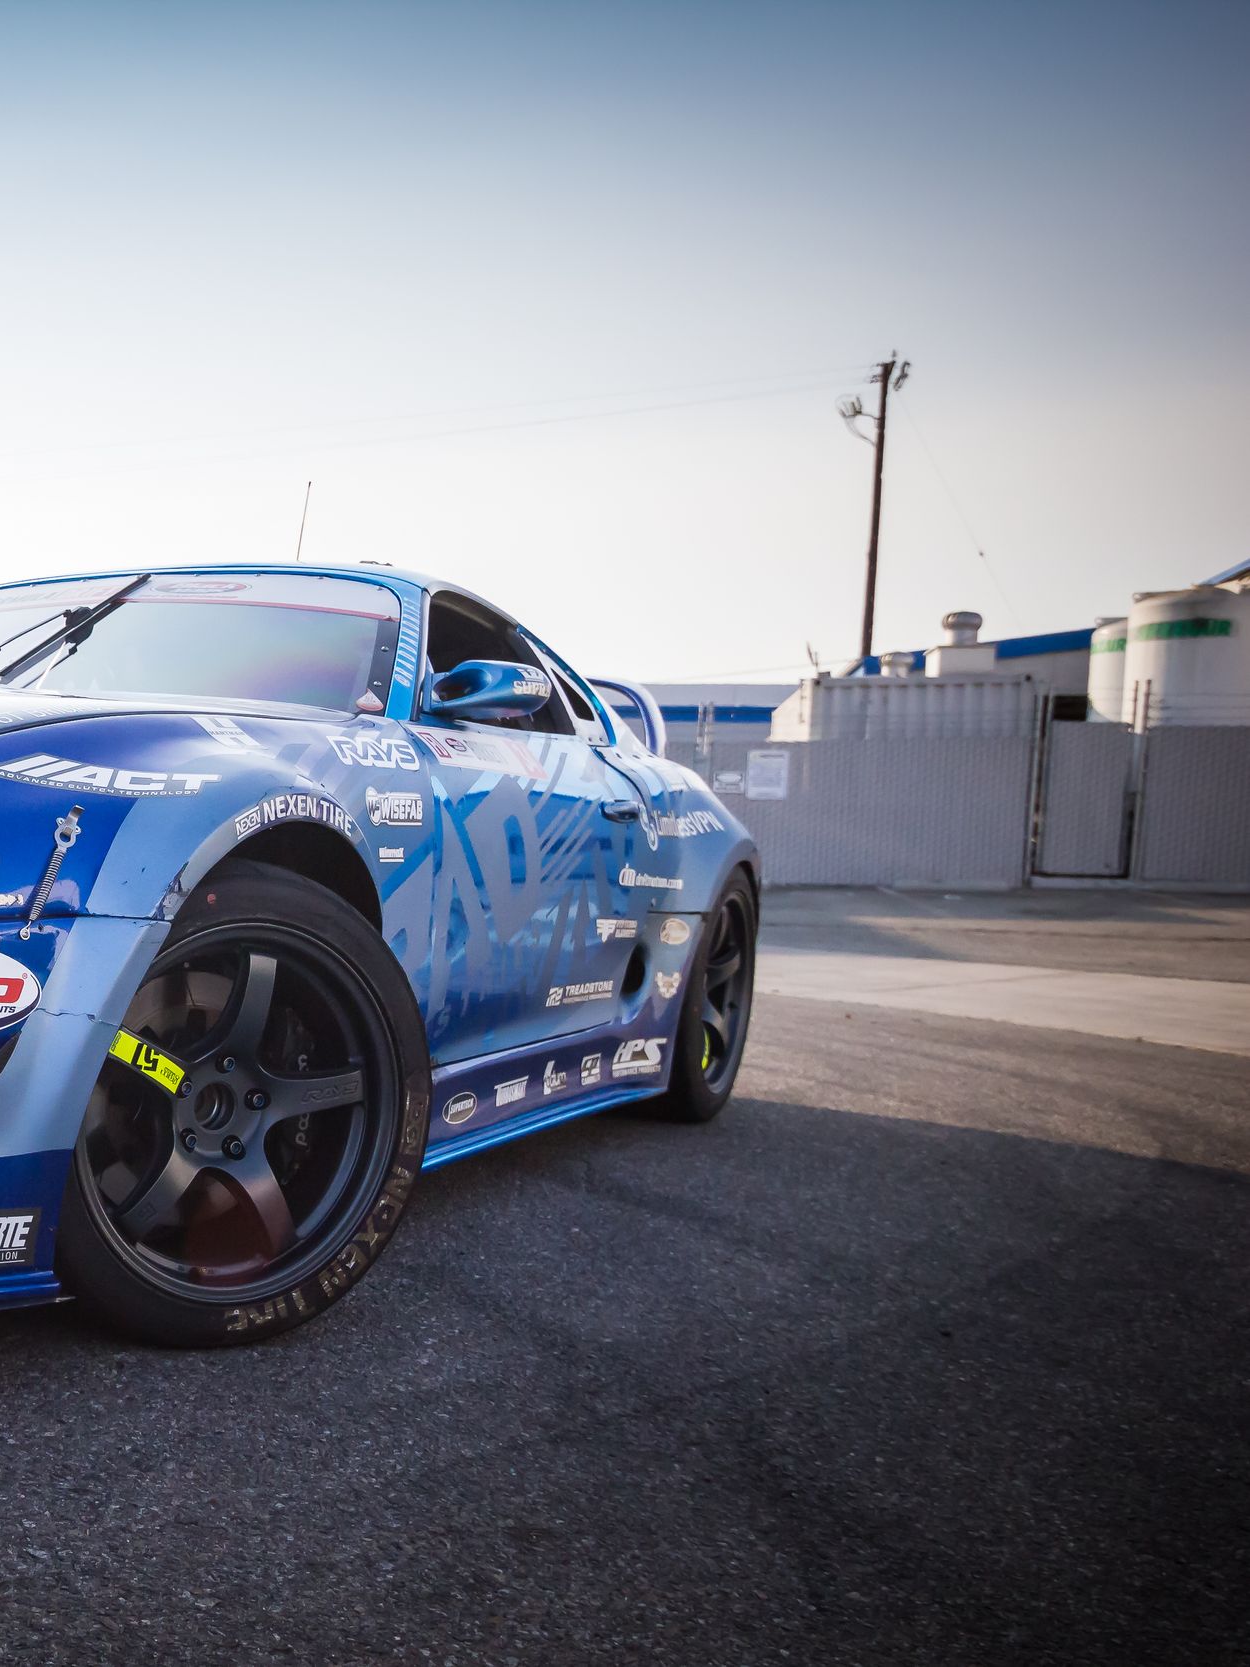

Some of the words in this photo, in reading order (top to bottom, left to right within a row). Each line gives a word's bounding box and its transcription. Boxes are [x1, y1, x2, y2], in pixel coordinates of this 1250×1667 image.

[326, 735, 420, 771] RAYS
[68, 783, 115, 795] CLUTCH
[119, 789, 200, 797] TECHNOLOGY
[263, 794, 317, 824] NEXEN
[319, 800, 353, 838] TIRE
[381, 796, 423, 820] WISEFAB
[565, 980, 614, 997] TREADSTONE
[612, 1037, 668, 1066] HPS
